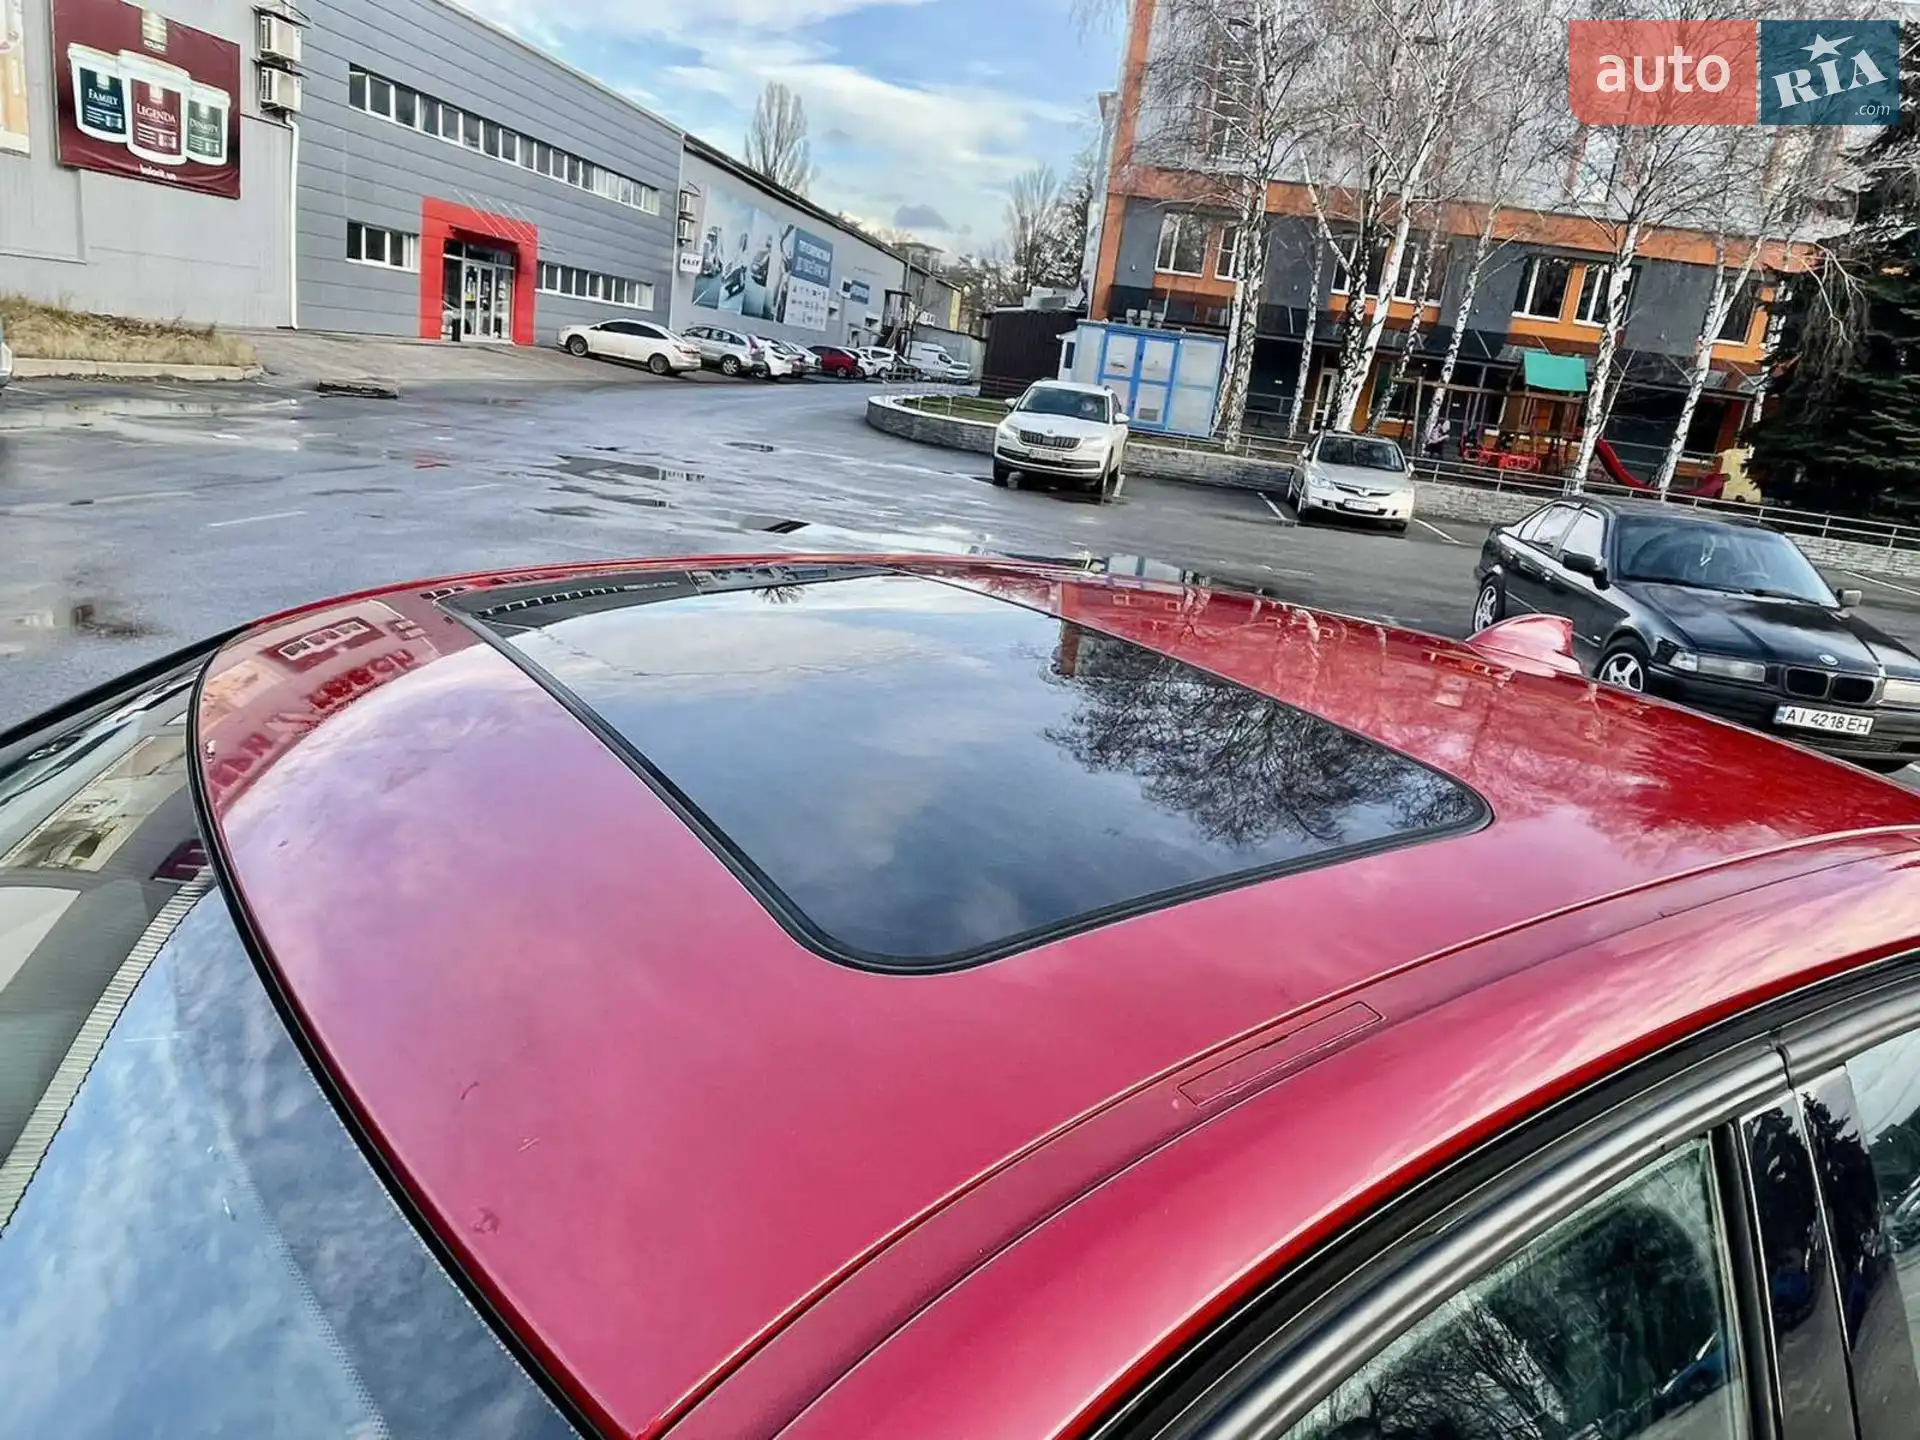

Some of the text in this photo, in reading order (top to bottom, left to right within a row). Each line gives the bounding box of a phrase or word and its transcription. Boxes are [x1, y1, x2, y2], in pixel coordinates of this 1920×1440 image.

[88, 88, 119, 105] FAMILY
[136, 102, 176, 123] LEGENDA
[1786, 709, 1870, 732] AI 4218 EH
